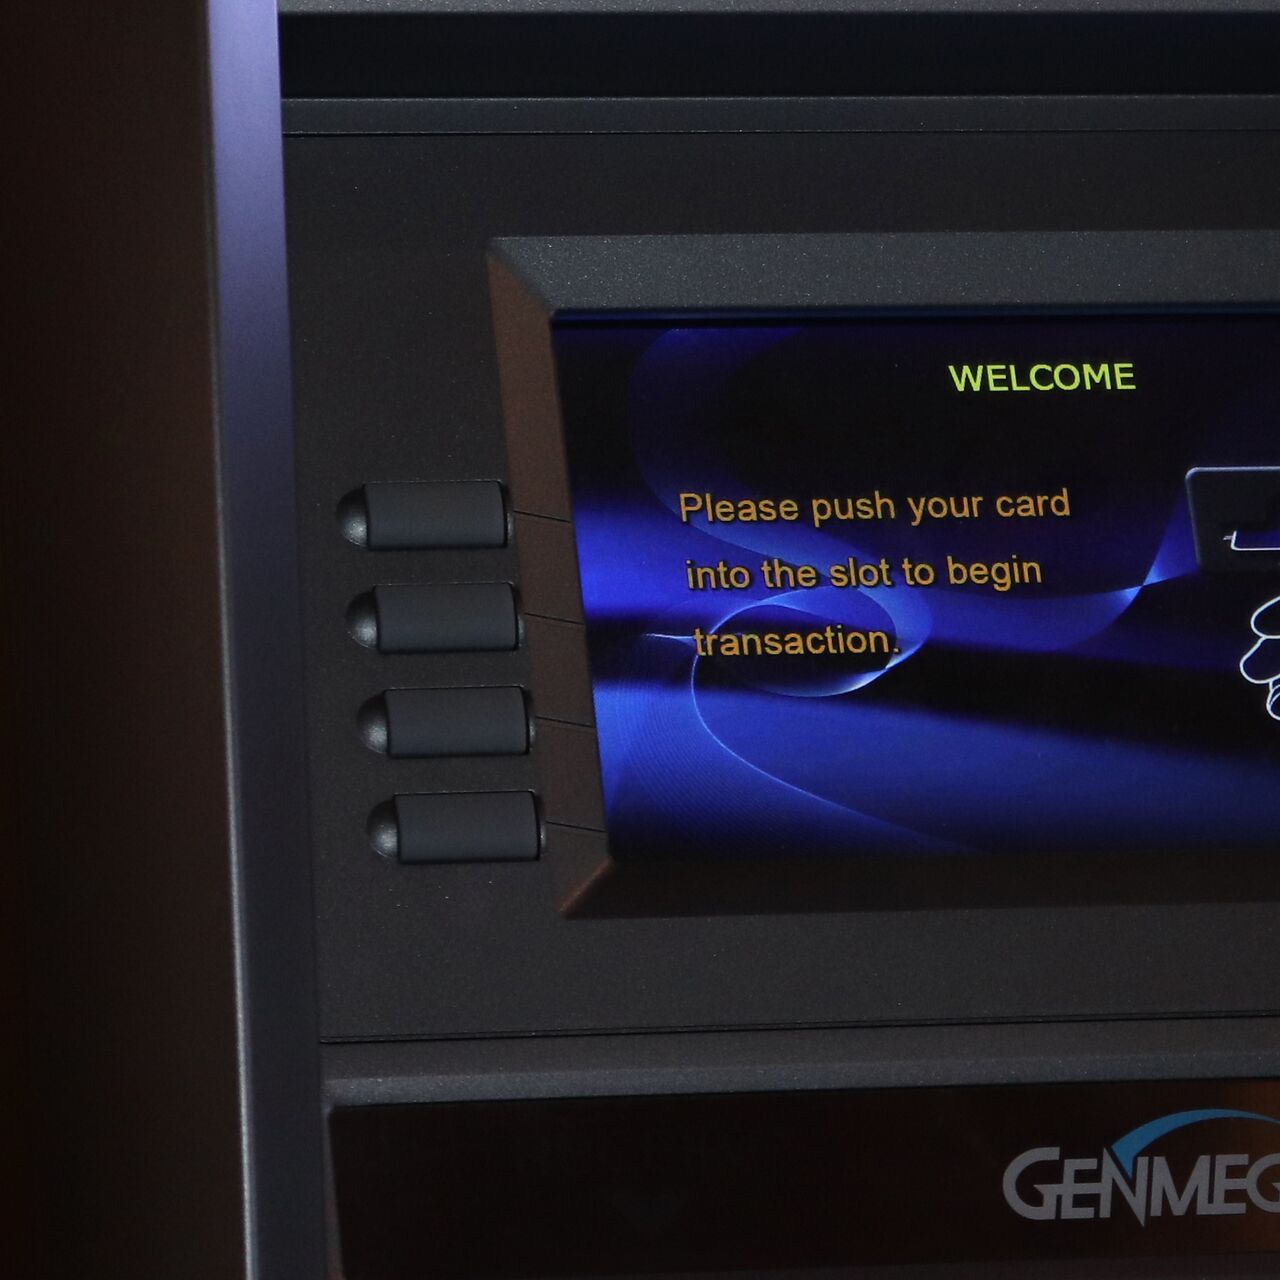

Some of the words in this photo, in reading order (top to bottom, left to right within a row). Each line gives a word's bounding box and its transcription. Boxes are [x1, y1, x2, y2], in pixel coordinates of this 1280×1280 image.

[948, 363, 1137, 392] WELCOME
[679, 492, 799, 523] Please
[813, 490, 896, 527] push
[907, 492, 984, 526] your
[996, 487, 1071, 518] card
[686, 559, 750, 590] into
[761, 557, 817, 588] the
[830, 557, 893, 587] slot
[902, 558, 935, 586] to
[947, 555, 1042, 591] begin
[694, 625, 900, 656] transaction.
